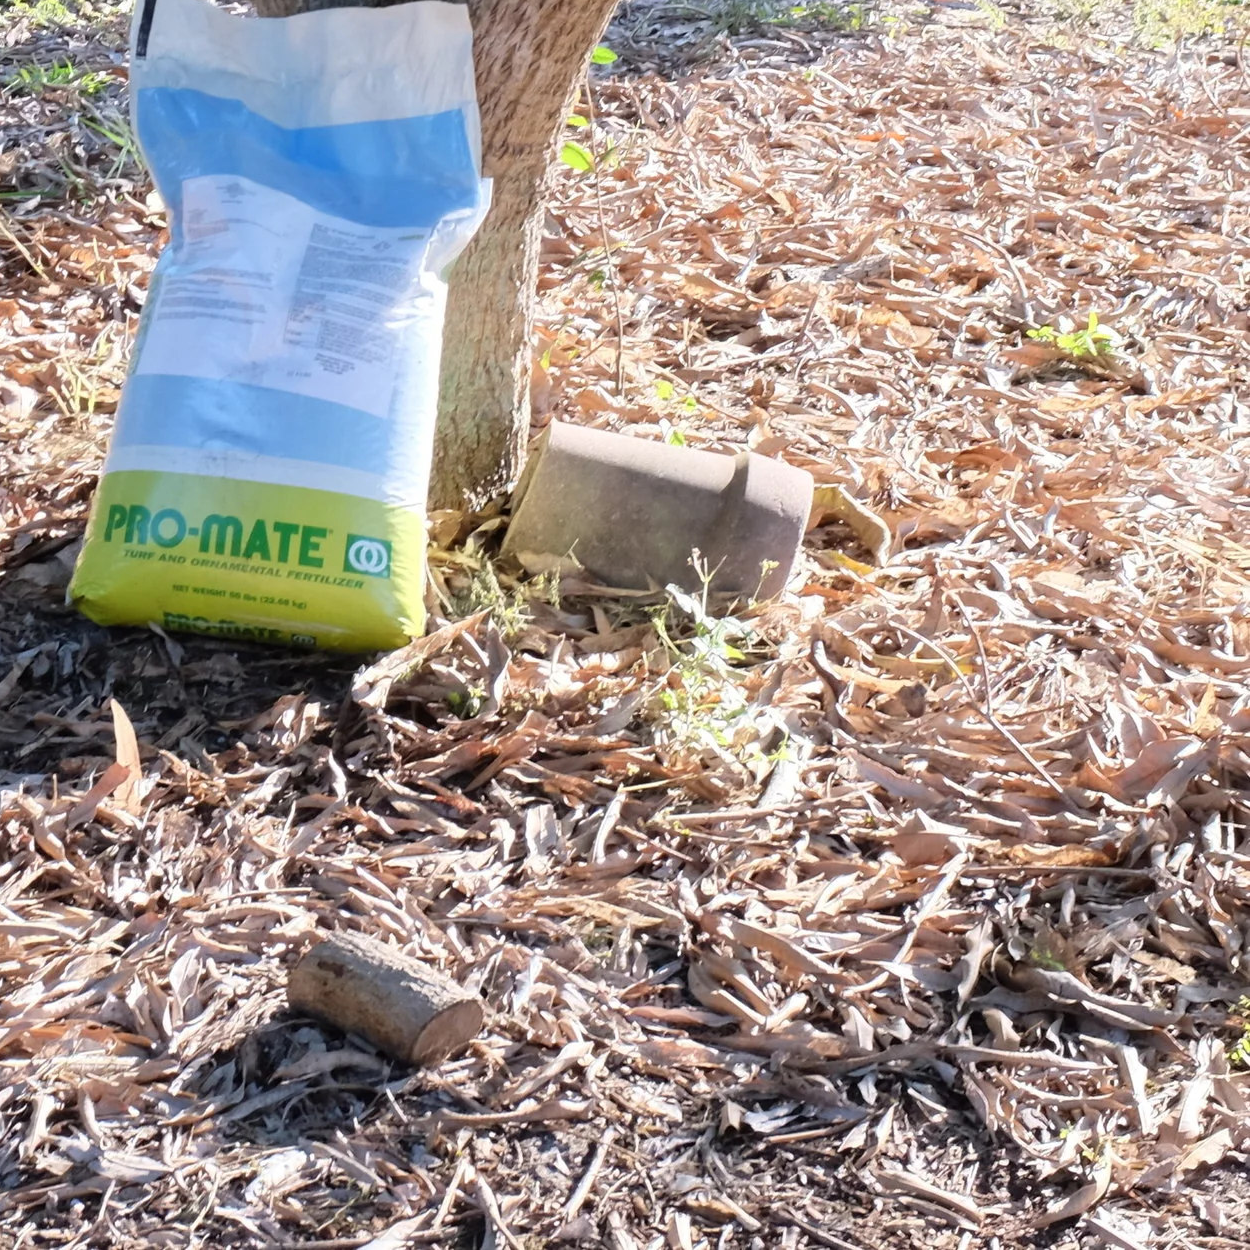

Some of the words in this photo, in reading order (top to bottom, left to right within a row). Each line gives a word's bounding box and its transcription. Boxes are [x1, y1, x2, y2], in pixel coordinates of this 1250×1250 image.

[103, 503, 328, 568] PRO-MATE
[123, 549, 155, 561] TURF
[158, 553, 187, 564] AND
[190, 558, 282, 578] ORNAMENTAL
[286, 570, 365, 589] FERTILIZER
[172, 584, 190, 593] NET
[192, 587, 227, 598] WEIGHT
